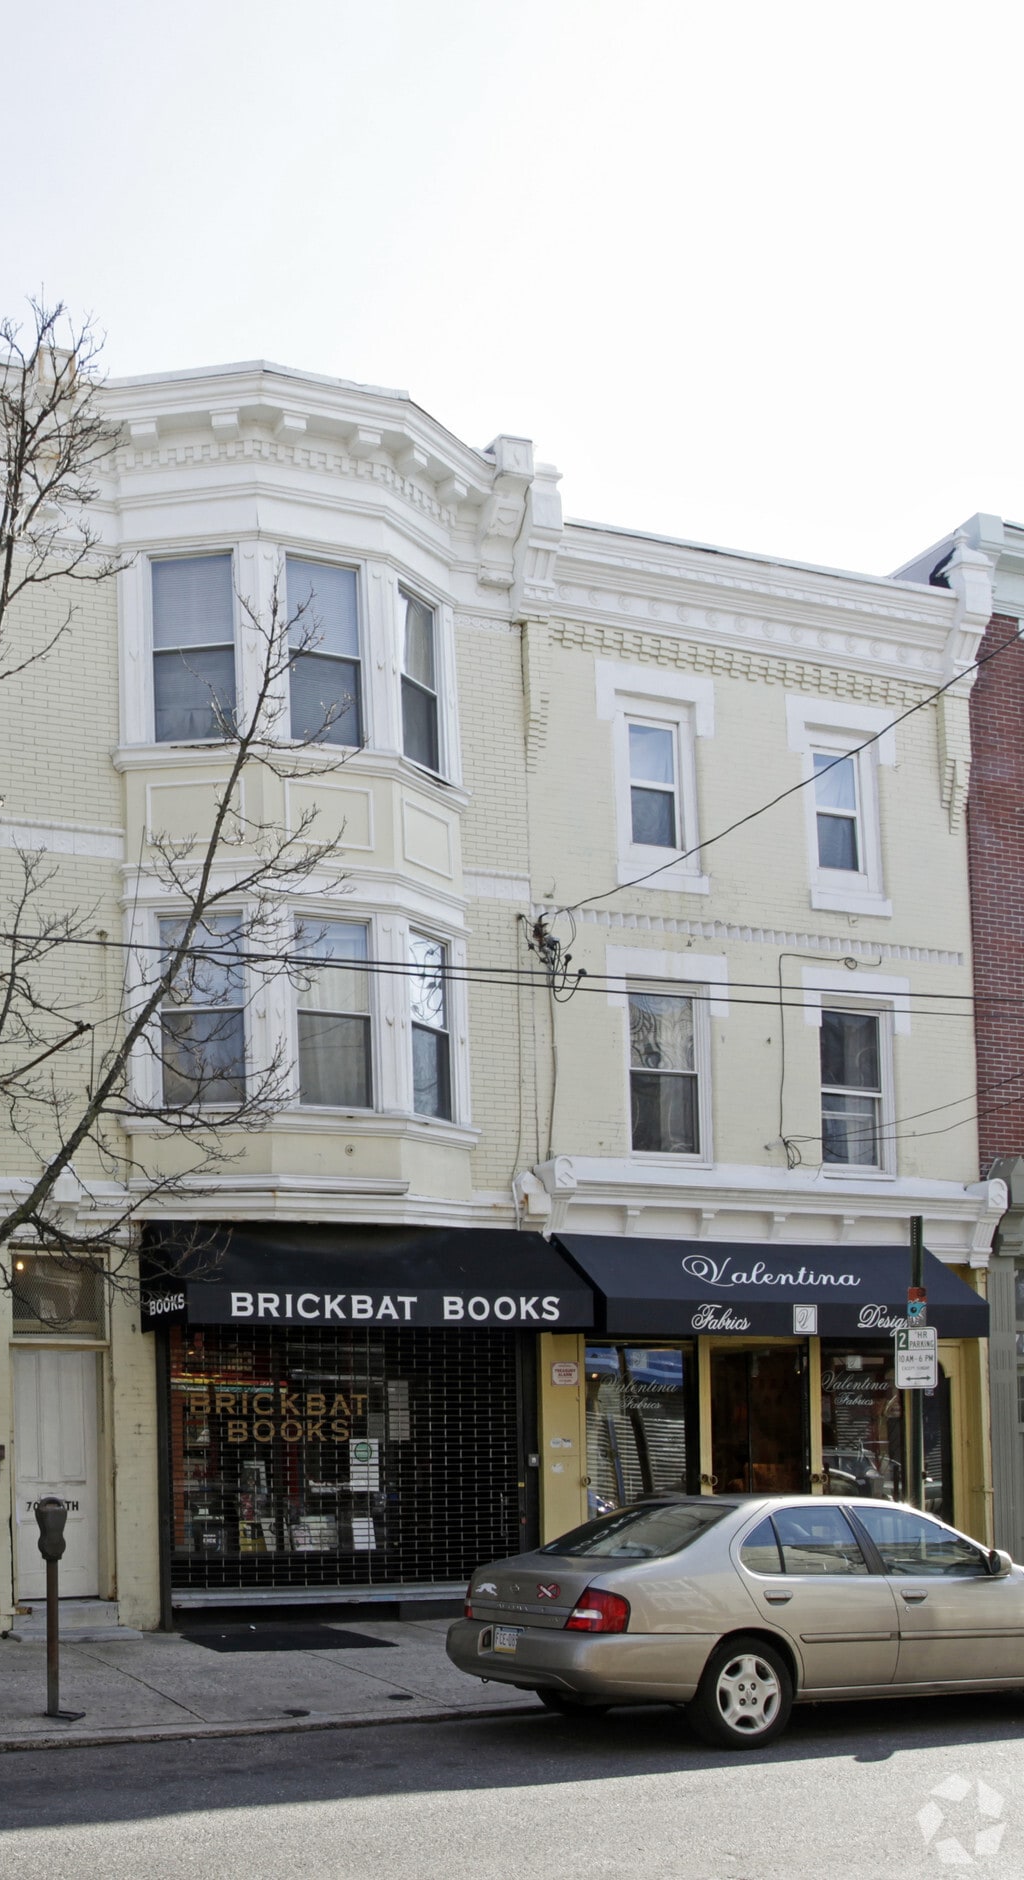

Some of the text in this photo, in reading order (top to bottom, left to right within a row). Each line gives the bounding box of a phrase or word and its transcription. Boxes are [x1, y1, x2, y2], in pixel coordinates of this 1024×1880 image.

[682, 1255, 861, 1287] Valentina
[149, 1293, 185, 1316] BOOKS
[230, 1292, 560, 1321] BRICKBAT BOOKS
[691, 1304, 751, 1331] Fabrics
[898, 1331, 928, 1348] 2 HR
[909, 1340, 935, 1348] PARKING
[600, 1374, 678, 1393] Valentina
[822, 1370, 889, 1392] Valentina
[190, 1393, 368, 1416] BRICKBAT
[227, 1420, 351, 1443] BOOKS
